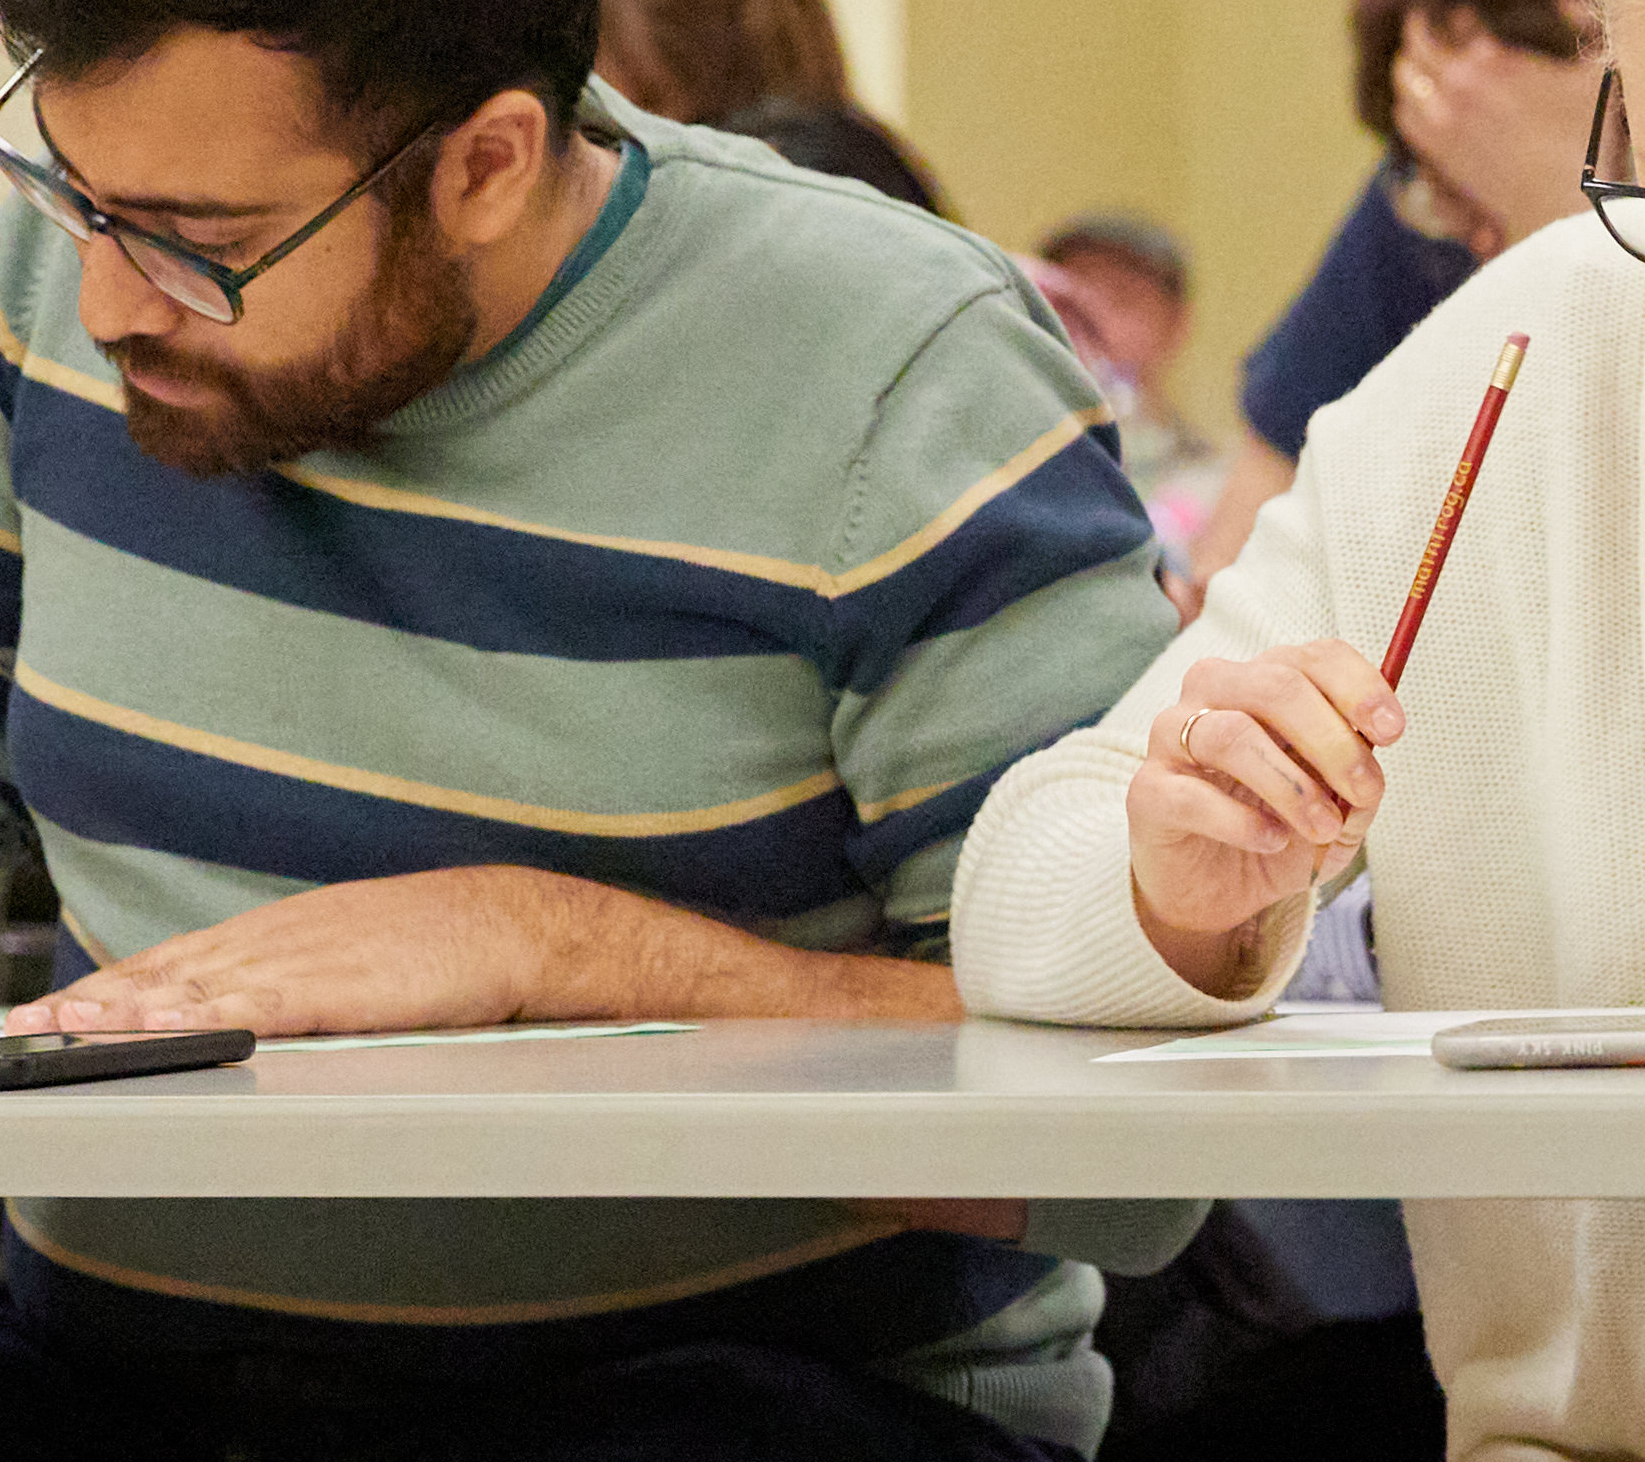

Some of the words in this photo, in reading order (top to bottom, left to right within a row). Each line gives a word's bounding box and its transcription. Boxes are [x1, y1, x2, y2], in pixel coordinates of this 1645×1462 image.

[1410, 461, 1473, 600] mathfrog.ca
[1517, 1040, 1553, 1056] SKY
[1561, 1040, 1604, 1056] PINK
